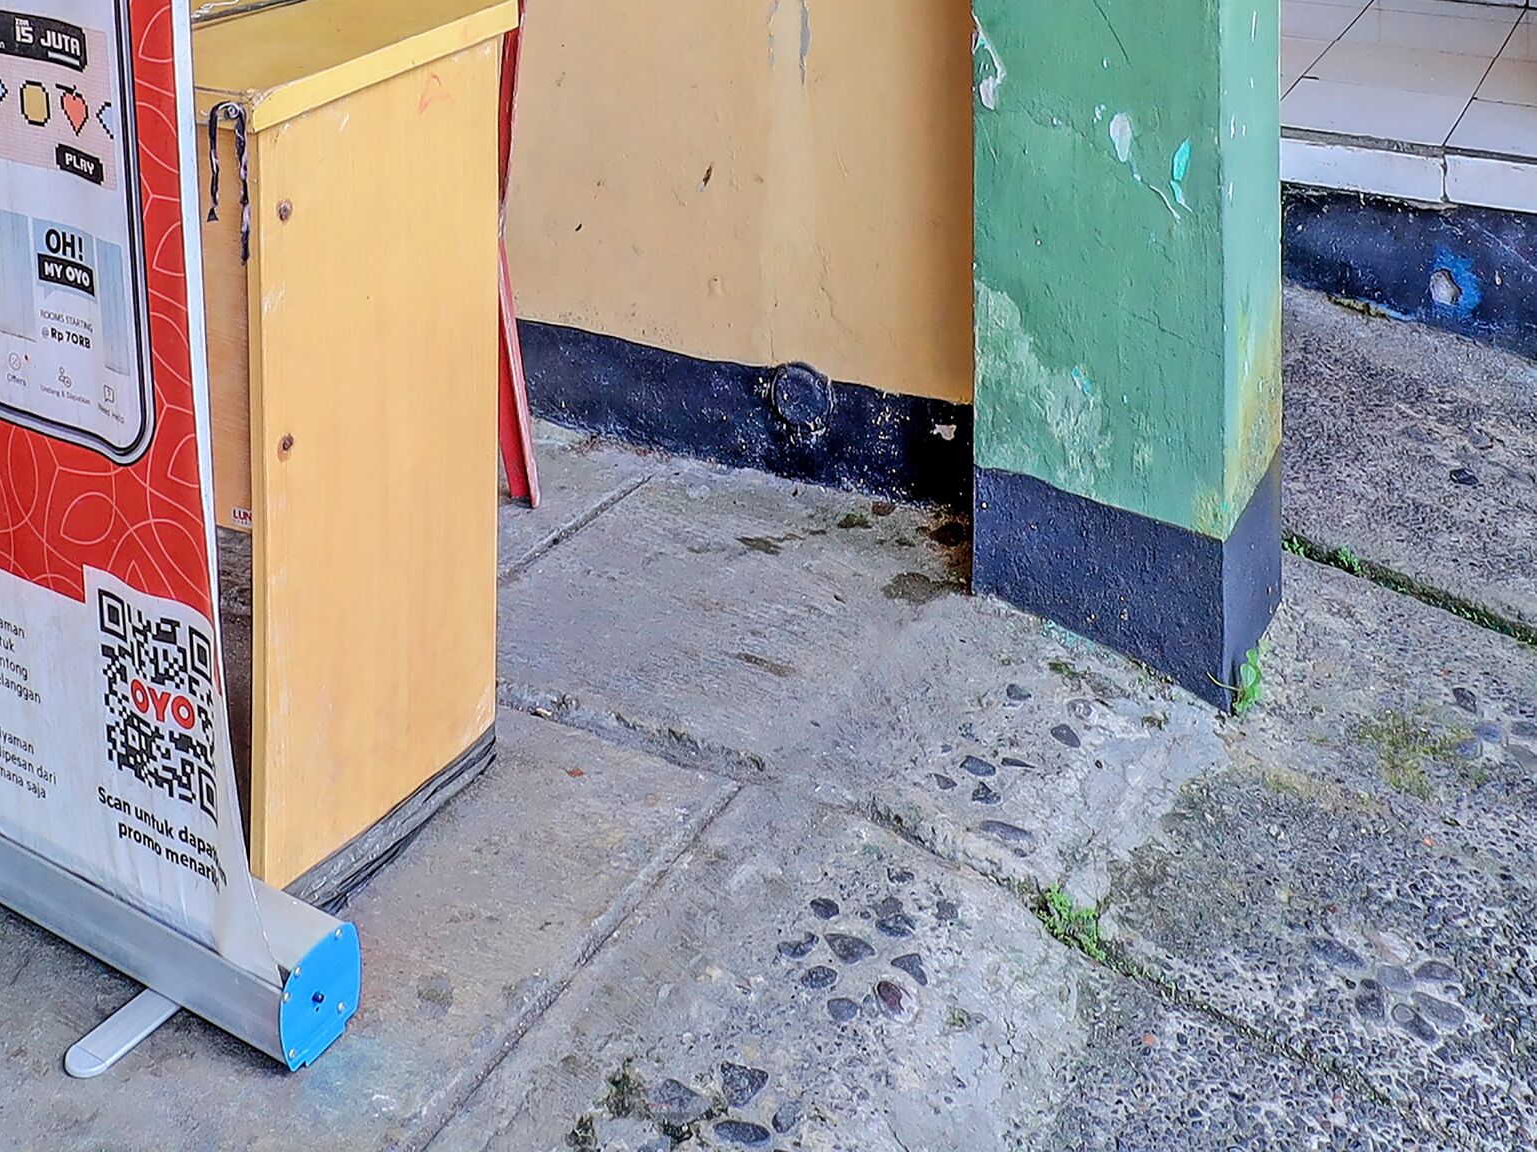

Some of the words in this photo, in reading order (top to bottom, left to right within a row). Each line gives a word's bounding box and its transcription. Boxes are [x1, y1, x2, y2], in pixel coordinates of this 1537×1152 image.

[15, 26, 33, 43] 15
[40, 30, 80, 56] JUTA
[65, 152, 94, 175] PLAY
[45, 229, 82, 261] OH!
[44, 261, 62, 278] MY
[65, 266, 89, 287] OYO
[40, 310, 64, 323] ROOMS
[65, 315, 93, 332] STARTING
[51, 328, 63, 342] Rp
[66, 331, 90, 348] 70RB
[131, 678, 195, 729] OYO
[37, 764, 56, 785] dari
[26, 779, 46, 798] saja
[98, 786, 130, 815] Scan
[135, 806, 174, 839] untuk
[118, 822, 161, 855] promo
